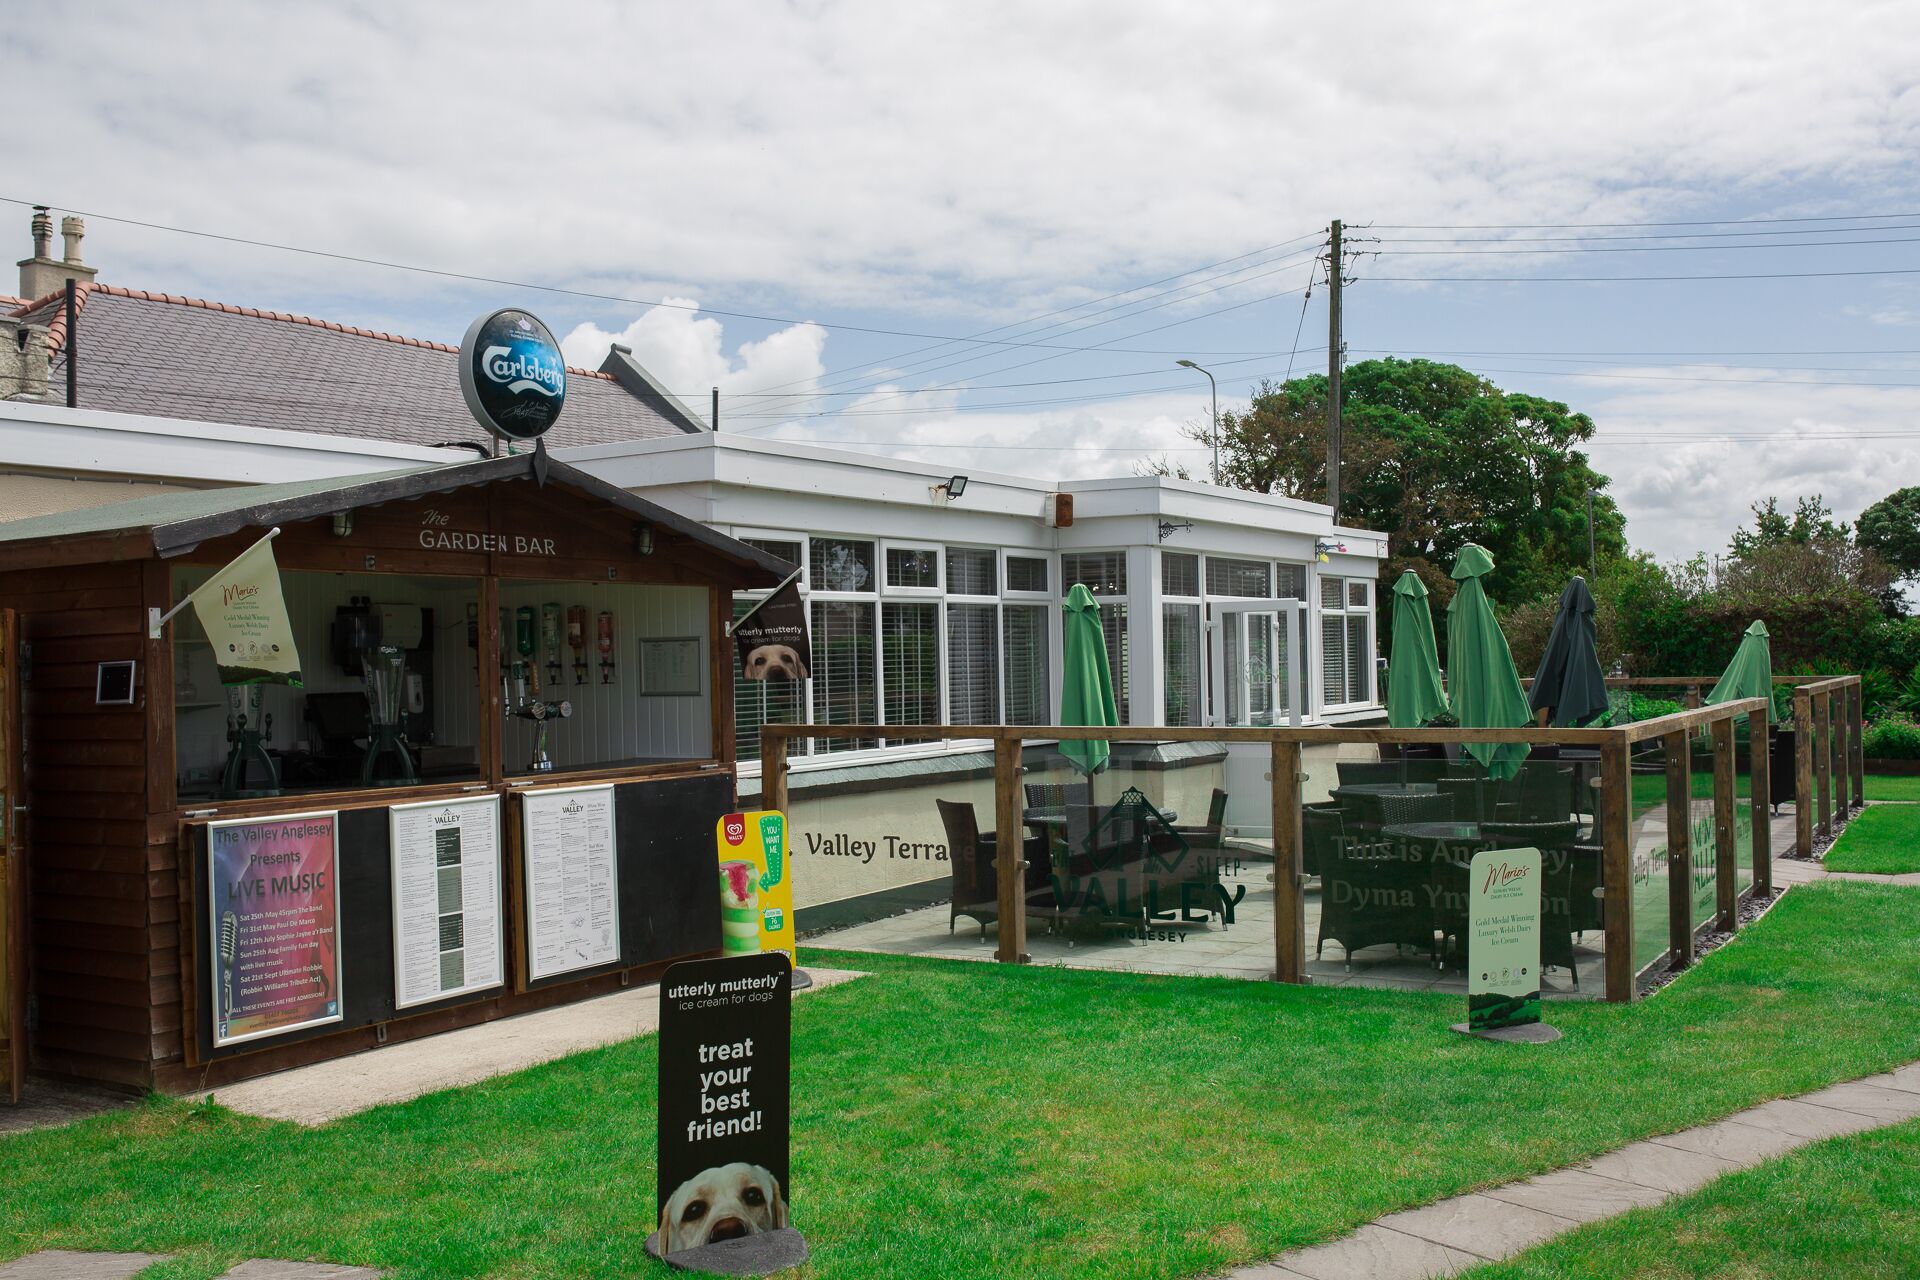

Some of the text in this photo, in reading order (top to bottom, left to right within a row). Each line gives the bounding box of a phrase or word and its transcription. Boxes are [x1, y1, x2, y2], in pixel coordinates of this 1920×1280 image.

[482, 345, 564, 397] Carlsberg
[422, 509, 450, 526] The
[420, 530, 556, 555] GARDEN BAR
[220, 584, 260, 606] Mario's
[738, 626, 802, 636] utterly mutterly
[562, 805, 584, 813] VALLEY
[434, 814, 460, 824] VALLEY
[216, 824, 332, 842] The Valley Anglesey
[766, 826, 778, 834] YOU
[766, 835, 780, 844] WANT
[770, 844, 778, 853] ME
[805, 832, 876, 864] Valley
[1331, 835, 1392, 861] This
[1400, 837, 1423, 862] is
[250, 851, 300, 866] Presents
[1634, 854, 1649, 887] alley
[1692, 843, 1716, 894] ALLE
[228, 872, 326, 900] LIVE MUSIC
[1483, 862, 1530, 894] Mario's
[1046, 874, 1246, 924] VALLEY
[1332, 880, 1416, 911] Dyma
[265, 912, 278, 920] May
[1475, 914, 1535, 927] Gold Medal Winning
[262, 923, 276, 932] May
[1107, 929, 1186, 942] NGLESEY
[1478, 924, 1531, 938] Luxury Welsh Dairy
[264, 935, 276, 944] July
[276, 931, 295, 942] Sophie
[296, 930, 312, 939] Jayne
[268, 947, 279, 955] Aug
[280, 943, 297, 953] Family
[309, 941, 319, 949] day
[264, 971, 278, 980] Sept
[279, 968, 301, 977] Ultimate
[302, 964, 322, 972] Robbie
[240, 986, 262, 997] (Robbie
[264, 982, 289, 991] Williams
[289, 977, 309, 986] Tribute
[668, 981, 716, 999] utterly
[679, 991, 773, 1011] ice cream for dogs
[699, 1038, 753, 1064] treat
[700, 1066, 751, 1093] your
[701, 1089, 750, 1114] best
[687, 1110, 762, 1142] friend!
